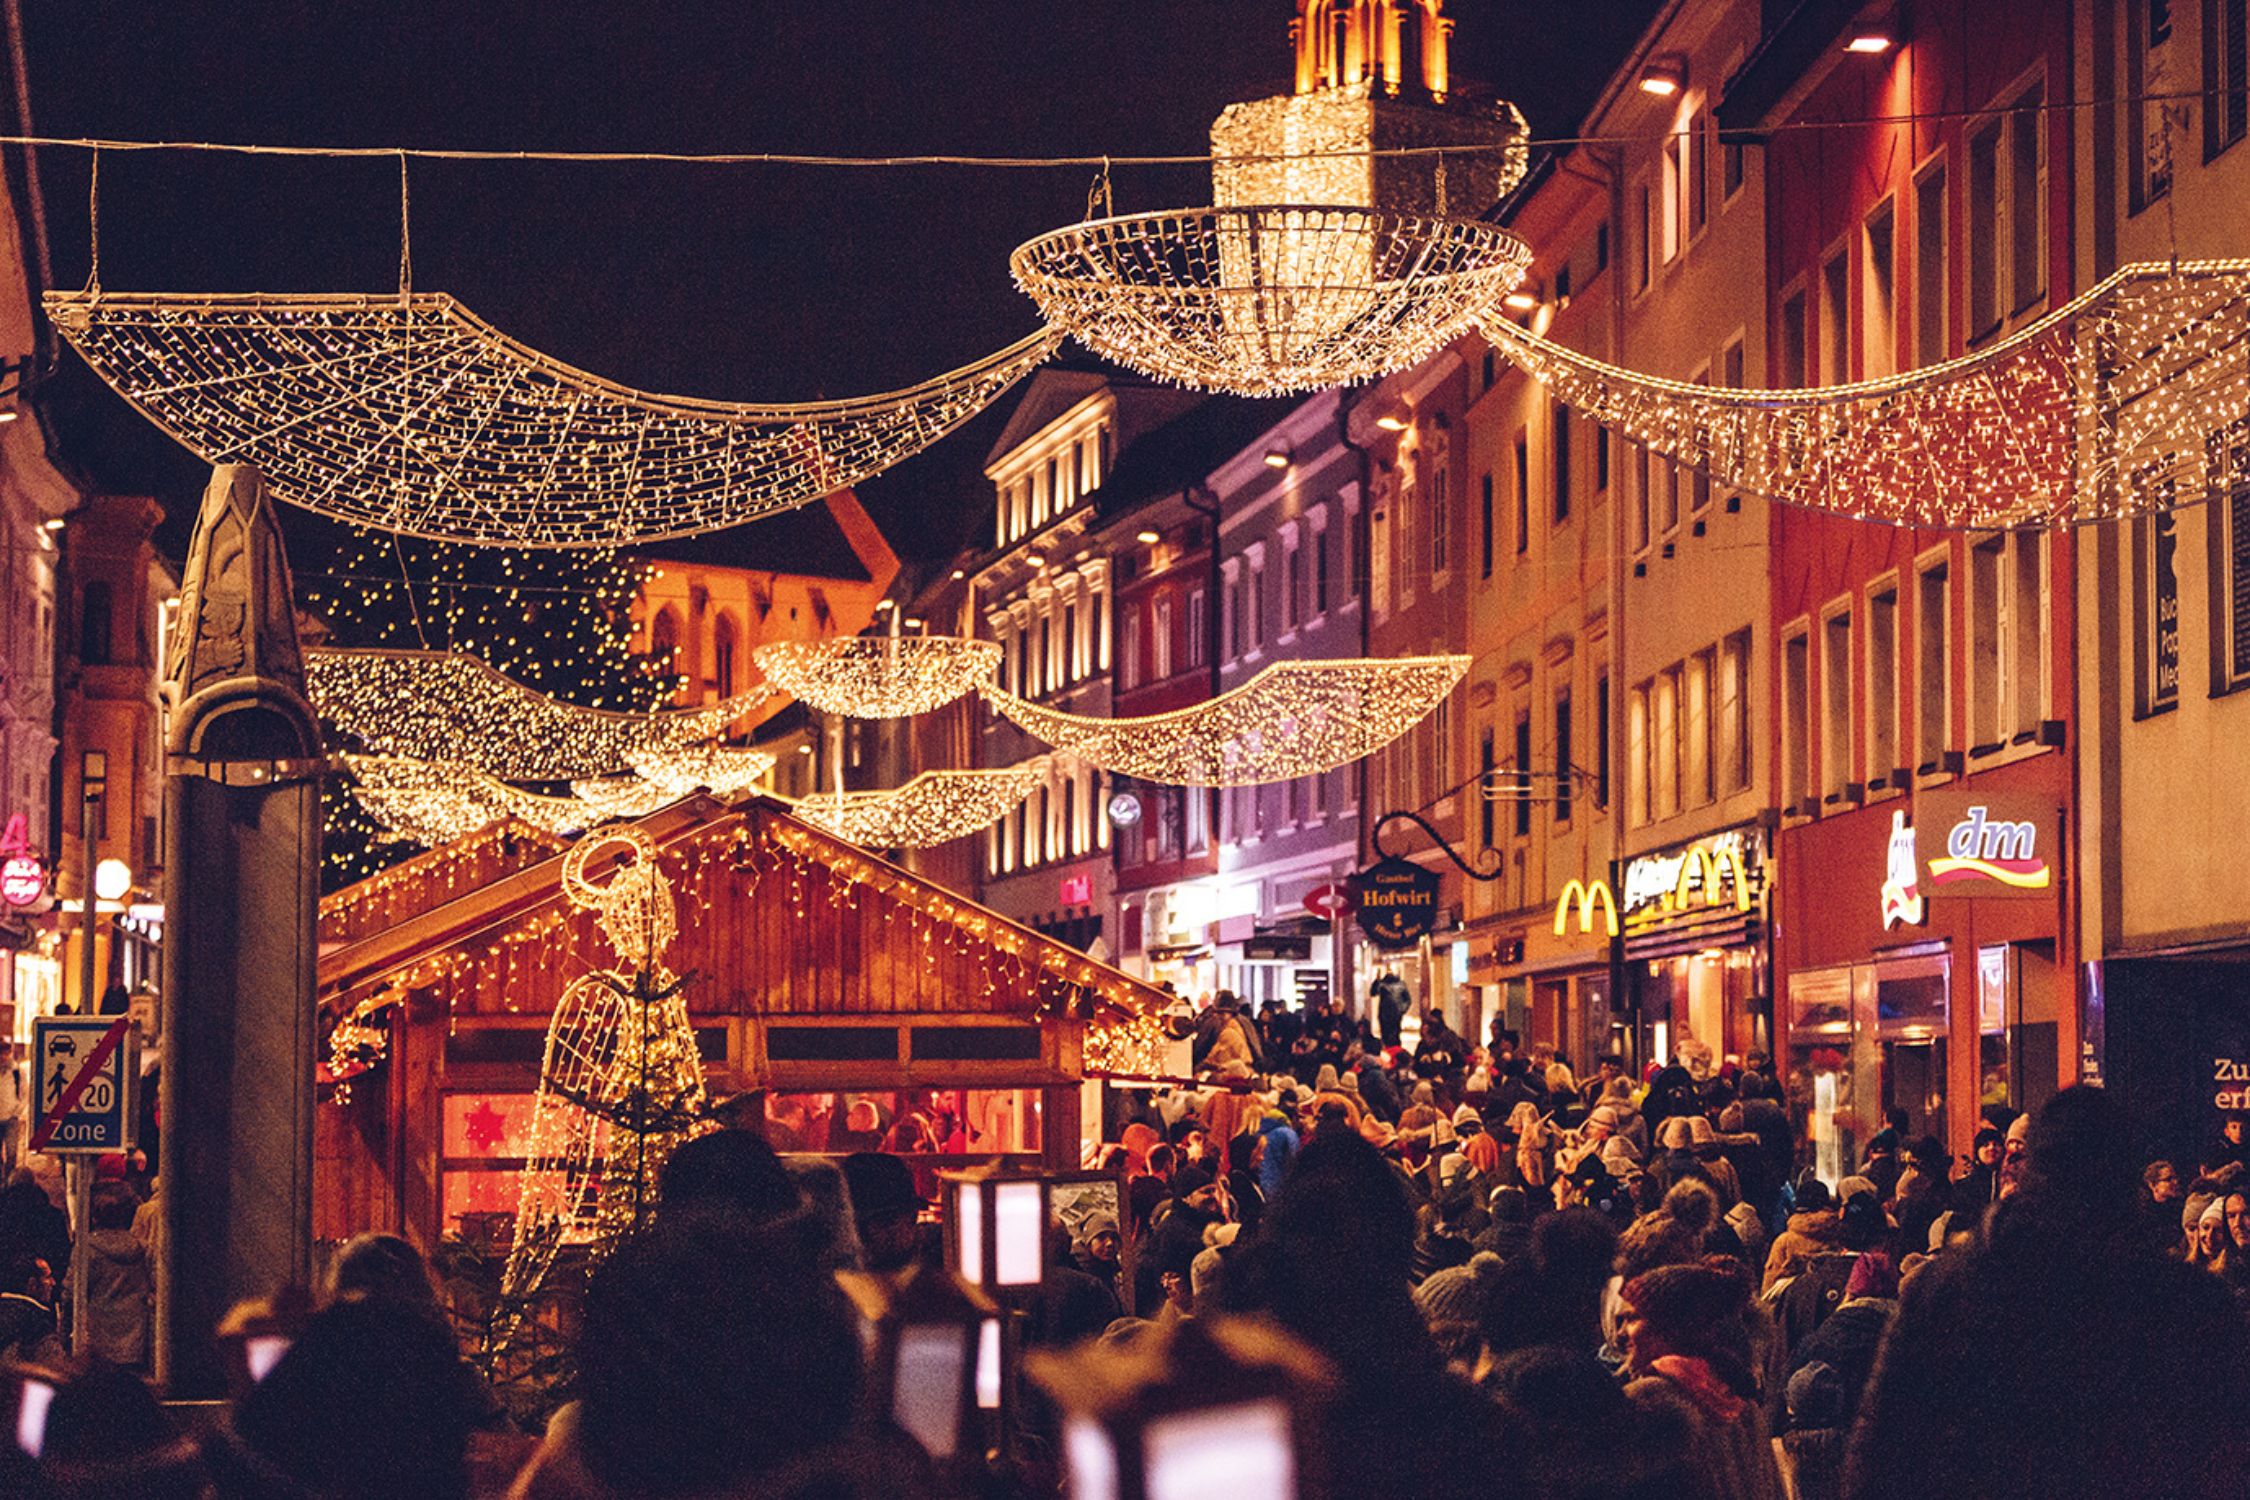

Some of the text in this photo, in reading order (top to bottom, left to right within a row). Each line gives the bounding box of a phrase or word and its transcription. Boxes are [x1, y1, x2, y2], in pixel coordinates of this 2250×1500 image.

[1948, 806, 2036, 859] dm
[1676, 845, 1750, 912] M
[1363, 889, 1431, 907] Hofwirt
[1553, 879, 1619, 936] M
[85, 1084, 110, 1107] 20
[50, 1120, 106, 1141] Zone
